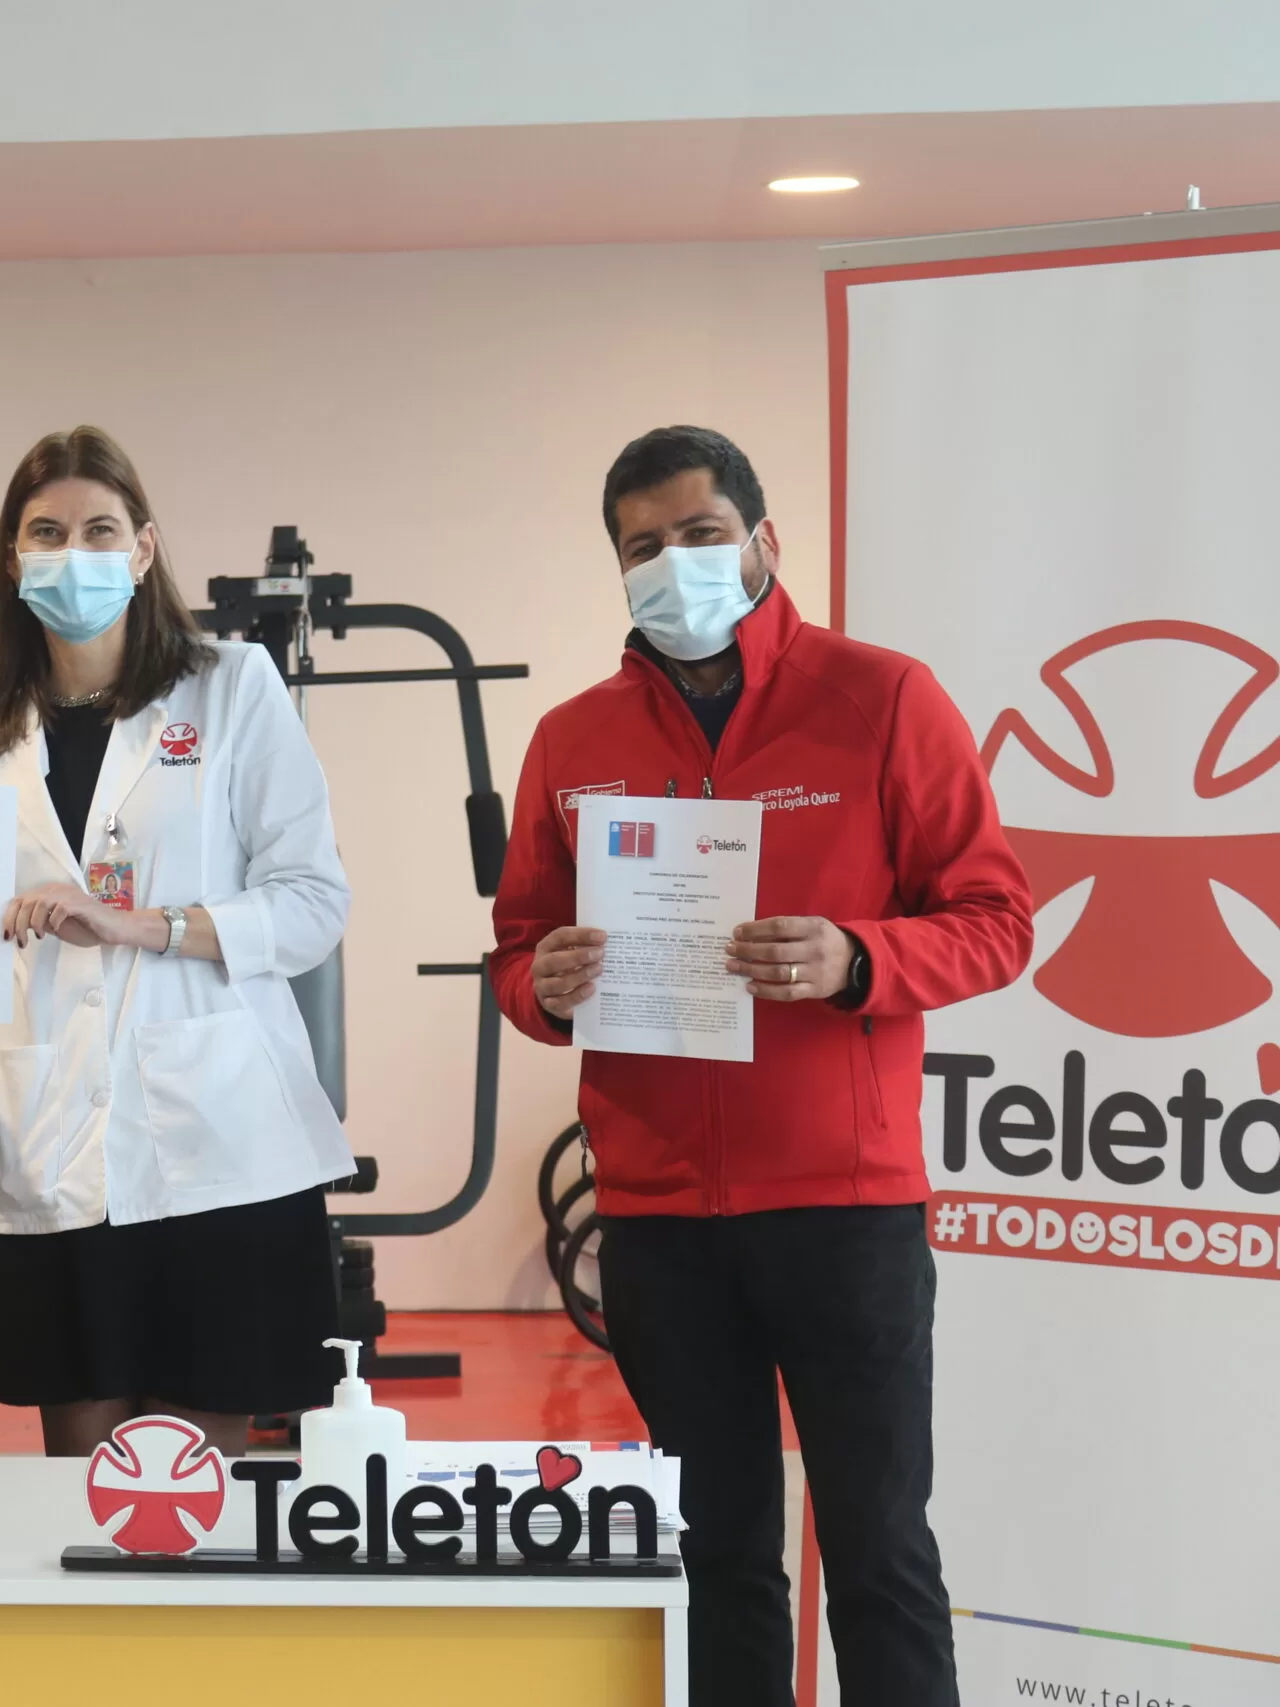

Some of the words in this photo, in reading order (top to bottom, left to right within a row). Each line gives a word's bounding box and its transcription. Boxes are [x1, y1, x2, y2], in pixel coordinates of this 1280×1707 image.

[160, 754, 201, 767] Teletón
[751, 785, 804, 801] SEREMI
[778, 795, 809, 811] Loyola
[811, 792, 841, 806] Quiroz
[713, 838, 747, 853] Teletón
[230, 1445, 658, 1562] Teletón
